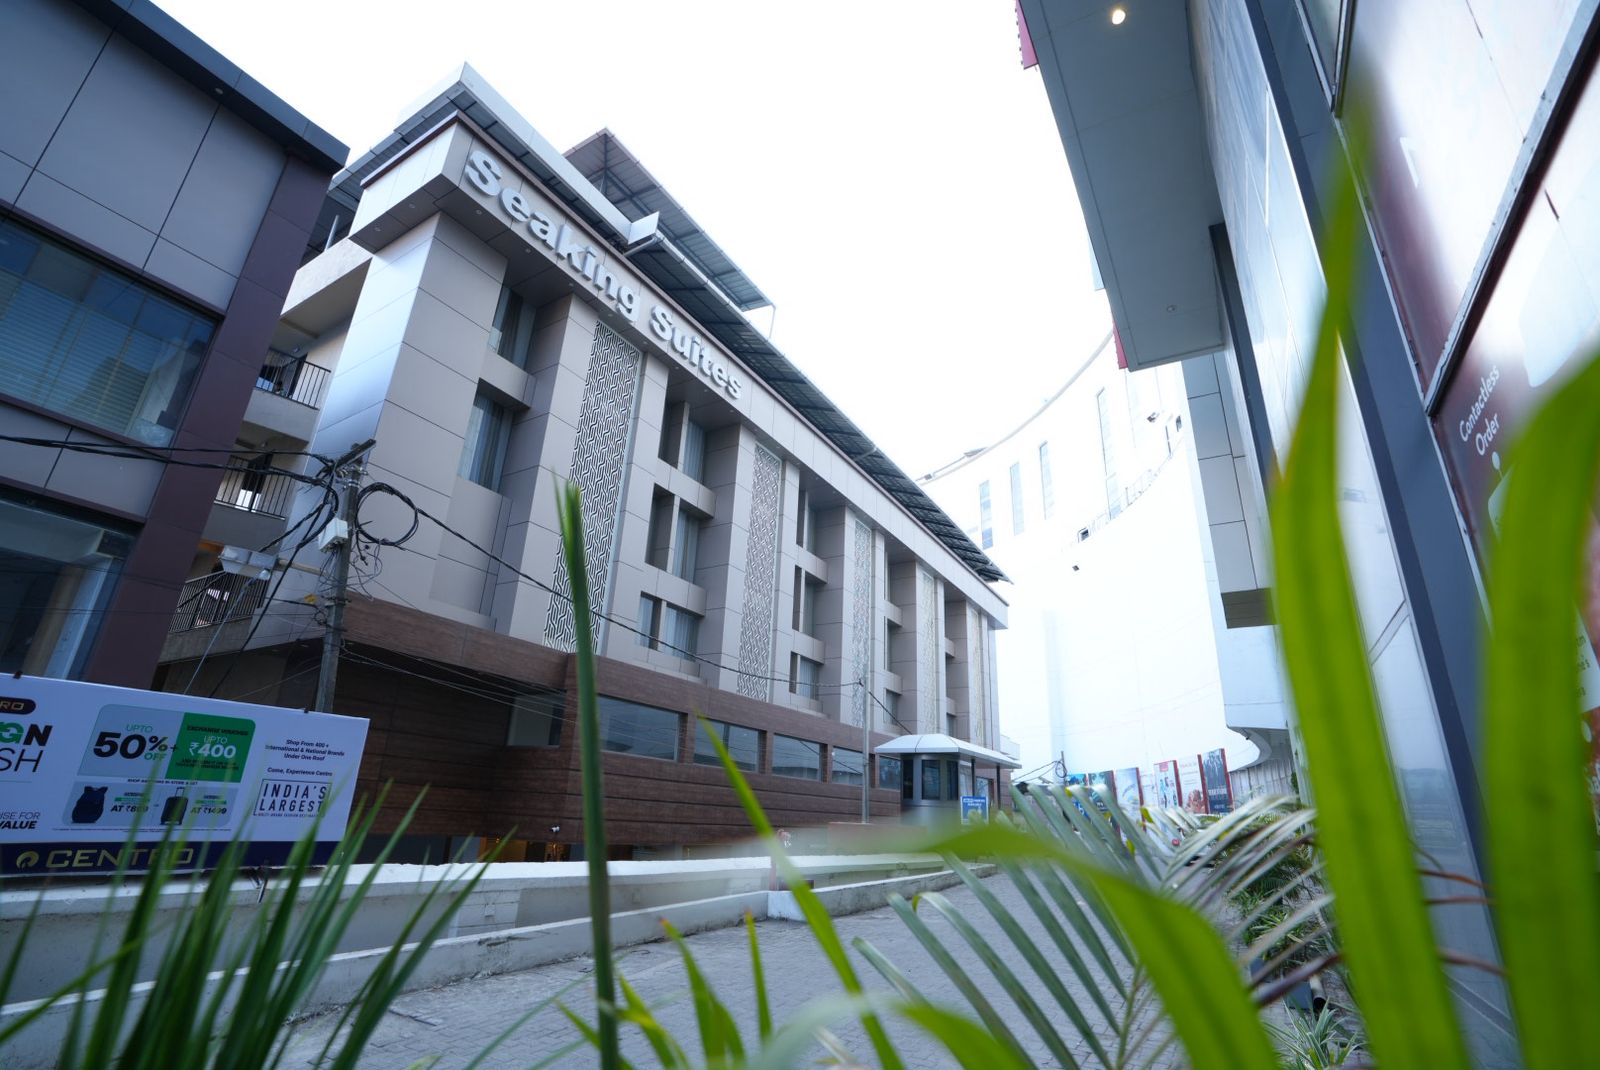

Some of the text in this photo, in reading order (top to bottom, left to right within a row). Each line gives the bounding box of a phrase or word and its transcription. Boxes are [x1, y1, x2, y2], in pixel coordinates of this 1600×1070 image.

[465, 150, 743, 400] Seaking Suites
[1459, 364, 1500, 442] Contactless
[1475, 412, 1500, 456] Order
[126, 723, 153, 733] UPTO
[203, 735, 228, 744] UPTO
[144, 752, 167, 761] OFF
[285, 768, 315, 776] Experience
[263, 783, 327, 799] INDIA'S
[259, 798, 324, 812] LARGEST
[19, 811, 40, 820] FOR
[46, 848, 194, 868] CENTO
